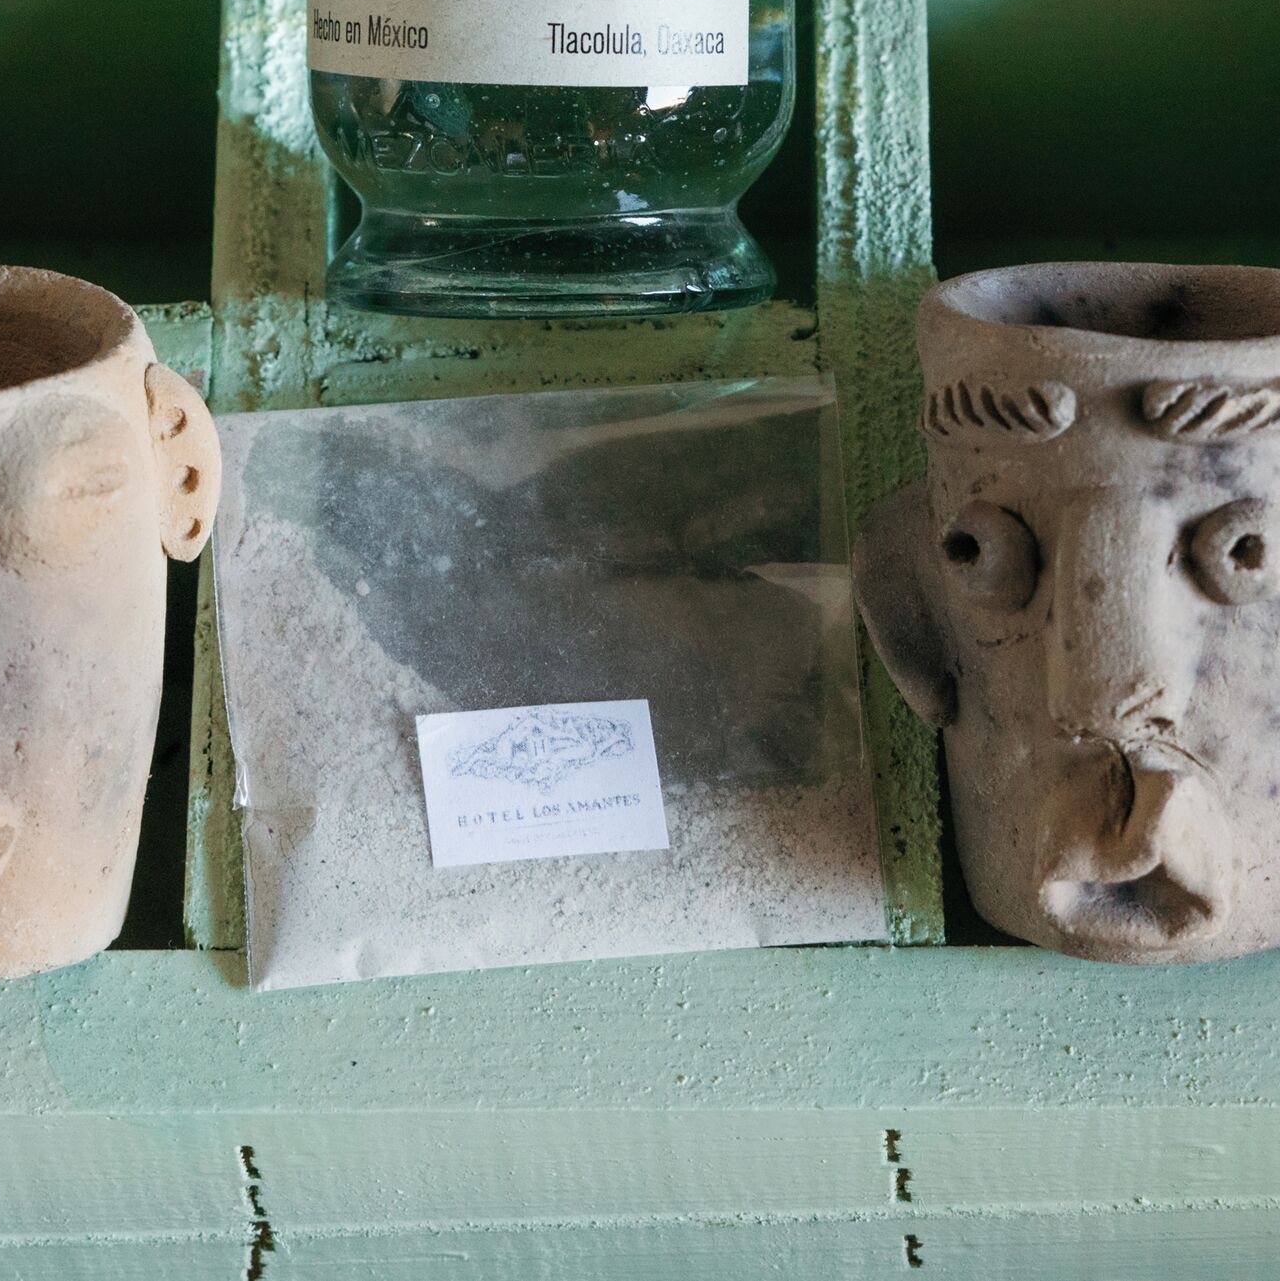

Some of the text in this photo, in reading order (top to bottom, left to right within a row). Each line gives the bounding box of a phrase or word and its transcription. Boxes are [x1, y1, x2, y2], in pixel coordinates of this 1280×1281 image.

[313, 8, 429, 49] Hecho en México
[547, 22, 725, 57] Tlacolula, Oaxaca
[457, 793, 641, 828] HOTEL LOS AMANTES
